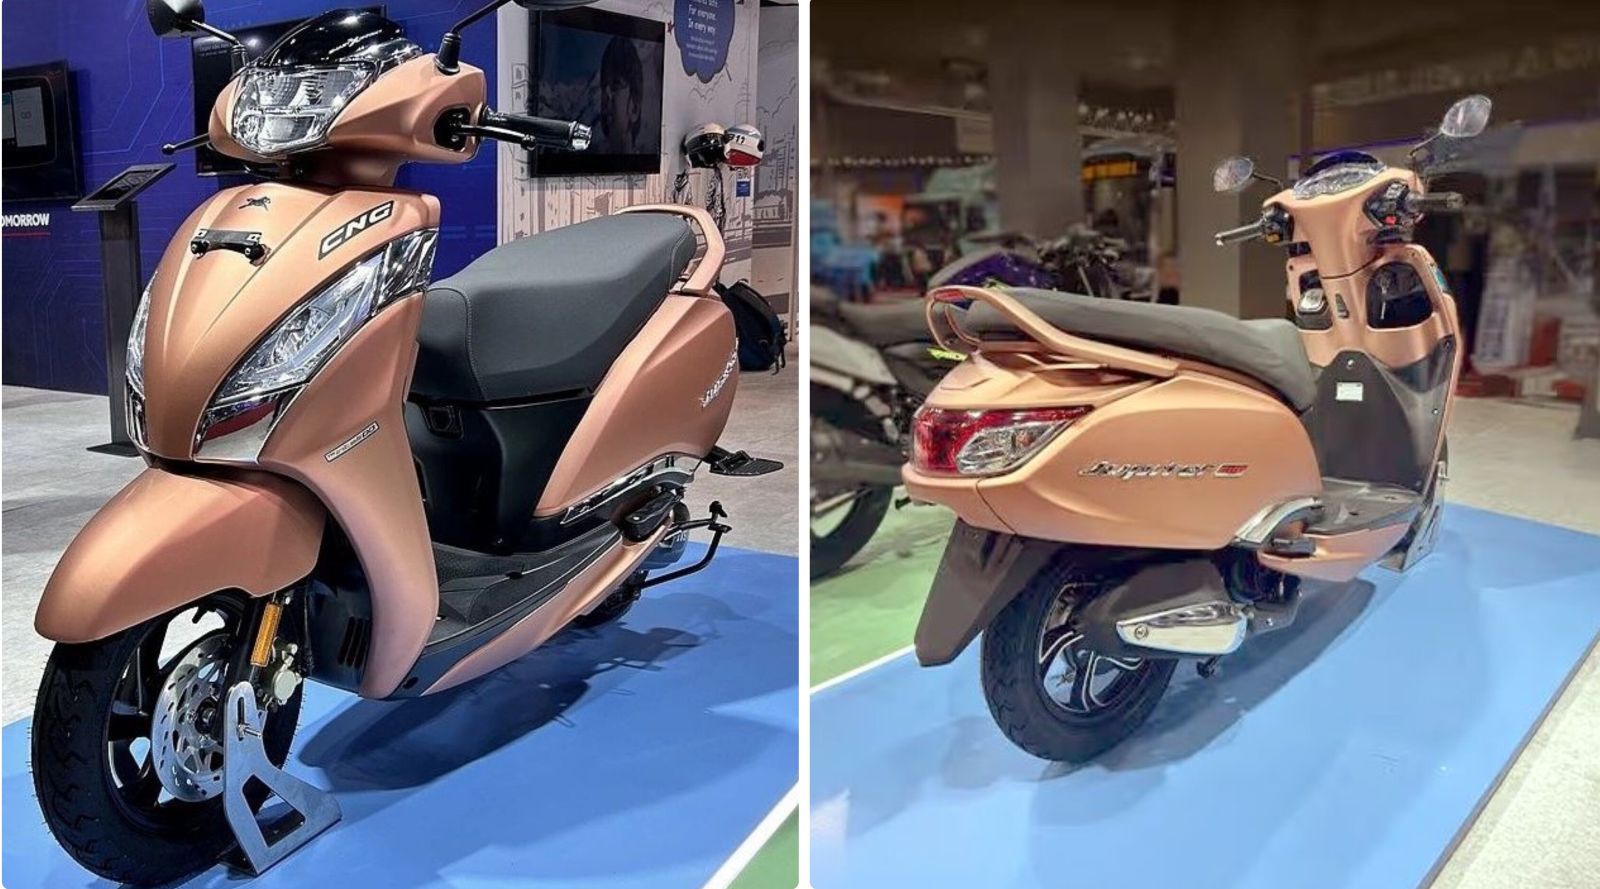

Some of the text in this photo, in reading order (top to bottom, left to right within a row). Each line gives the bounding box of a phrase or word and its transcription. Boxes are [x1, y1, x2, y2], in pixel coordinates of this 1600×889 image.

[688, 4, 697, 15] For
[321, 203, 392, 254] CNG
[1079, 460, 1215, 480] Jupiter
